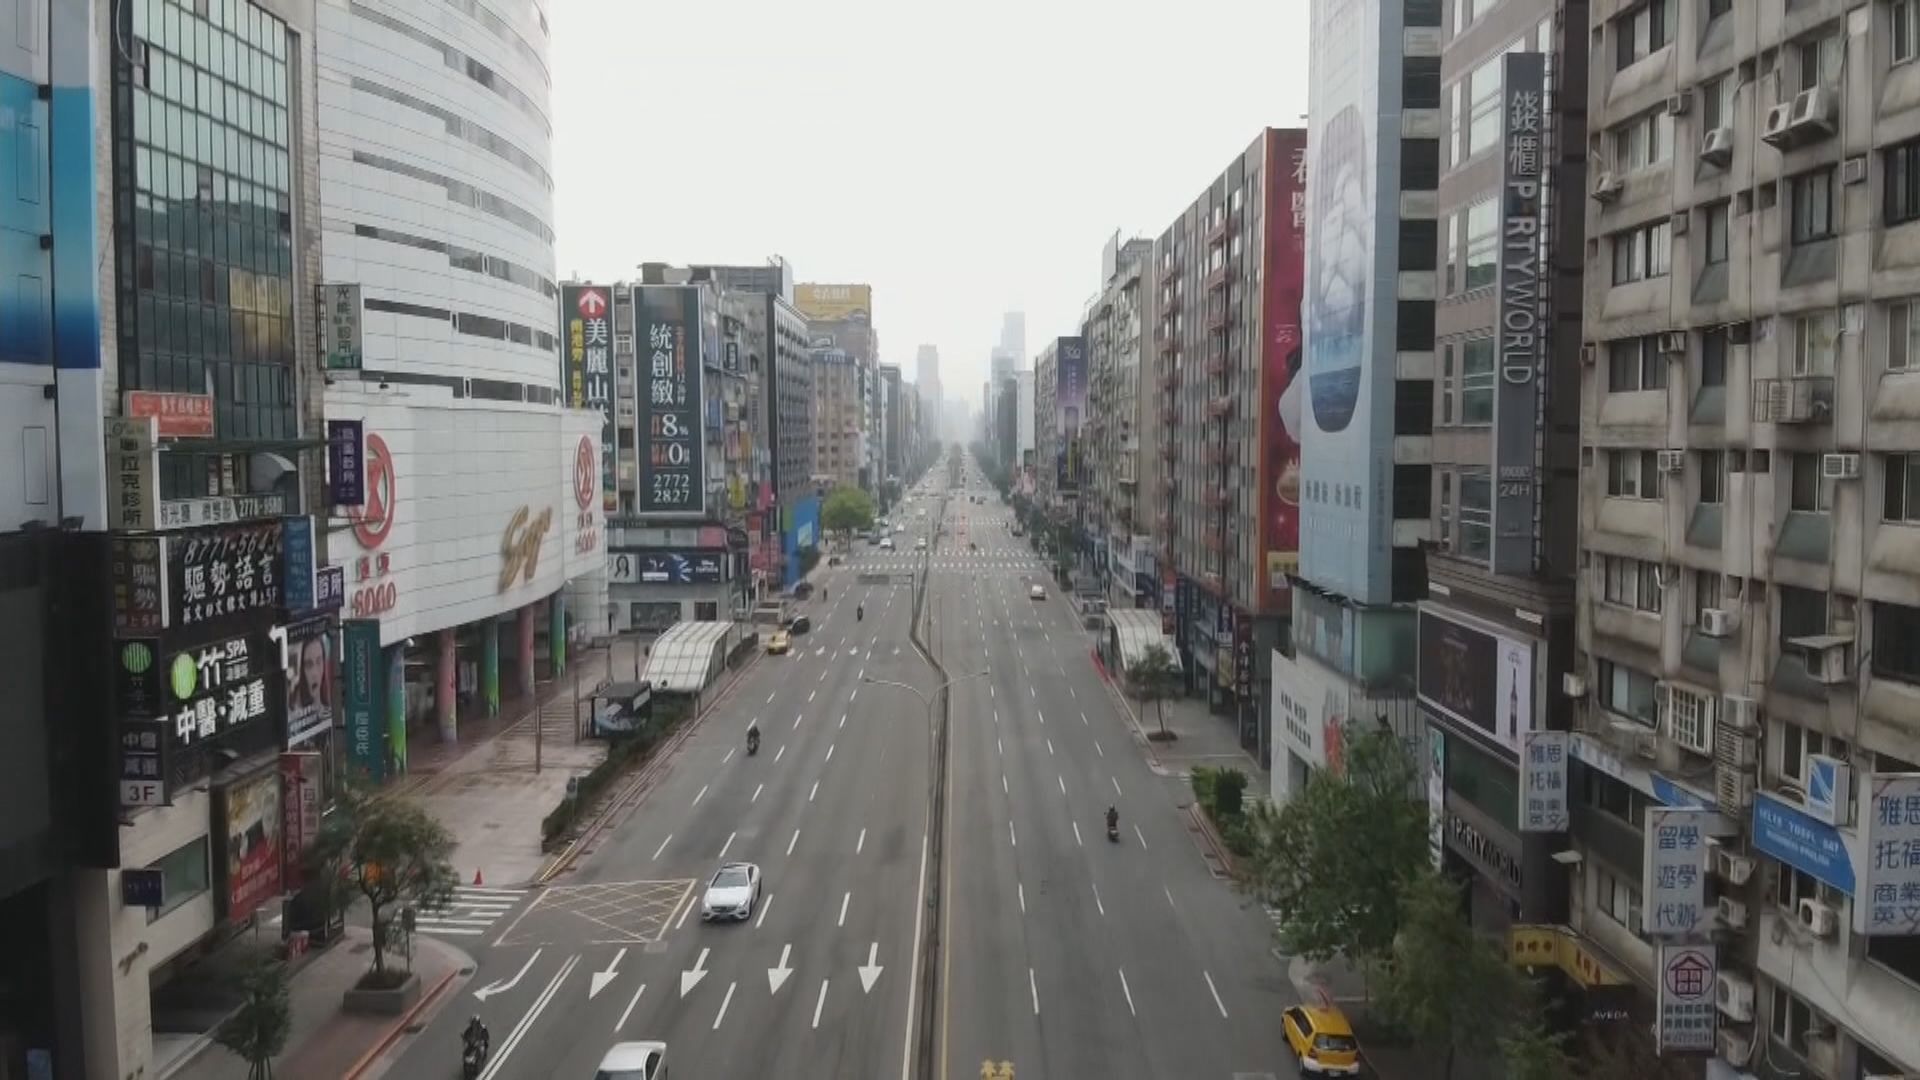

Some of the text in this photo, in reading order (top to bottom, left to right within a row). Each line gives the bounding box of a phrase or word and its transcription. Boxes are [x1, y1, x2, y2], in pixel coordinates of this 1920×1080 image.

[1503, 180, 1537, 385] PRTYWORLD
[653, 474, 690, 488] 2772
[1500, 484, 1531, 498] 24H
[653, 489, 690, 503] 2827
[183, 554, 275, 603] 驅勢語言
[352, 581, 396, 617] SOGO
[225, 638, 247, 660] SPA
[1530, 744, 1562, 763] 雅思
[1530, 772, 1562, 792] 托福
[128, 785, 156, 801] 3F
[1658, 826, 1699, 850] 留學
[1657, 864, 1697, 890] 遊學
[1656, 902, 1697, 929] 代辦
[1591, 1010, 1630, 1021] AVEDA
